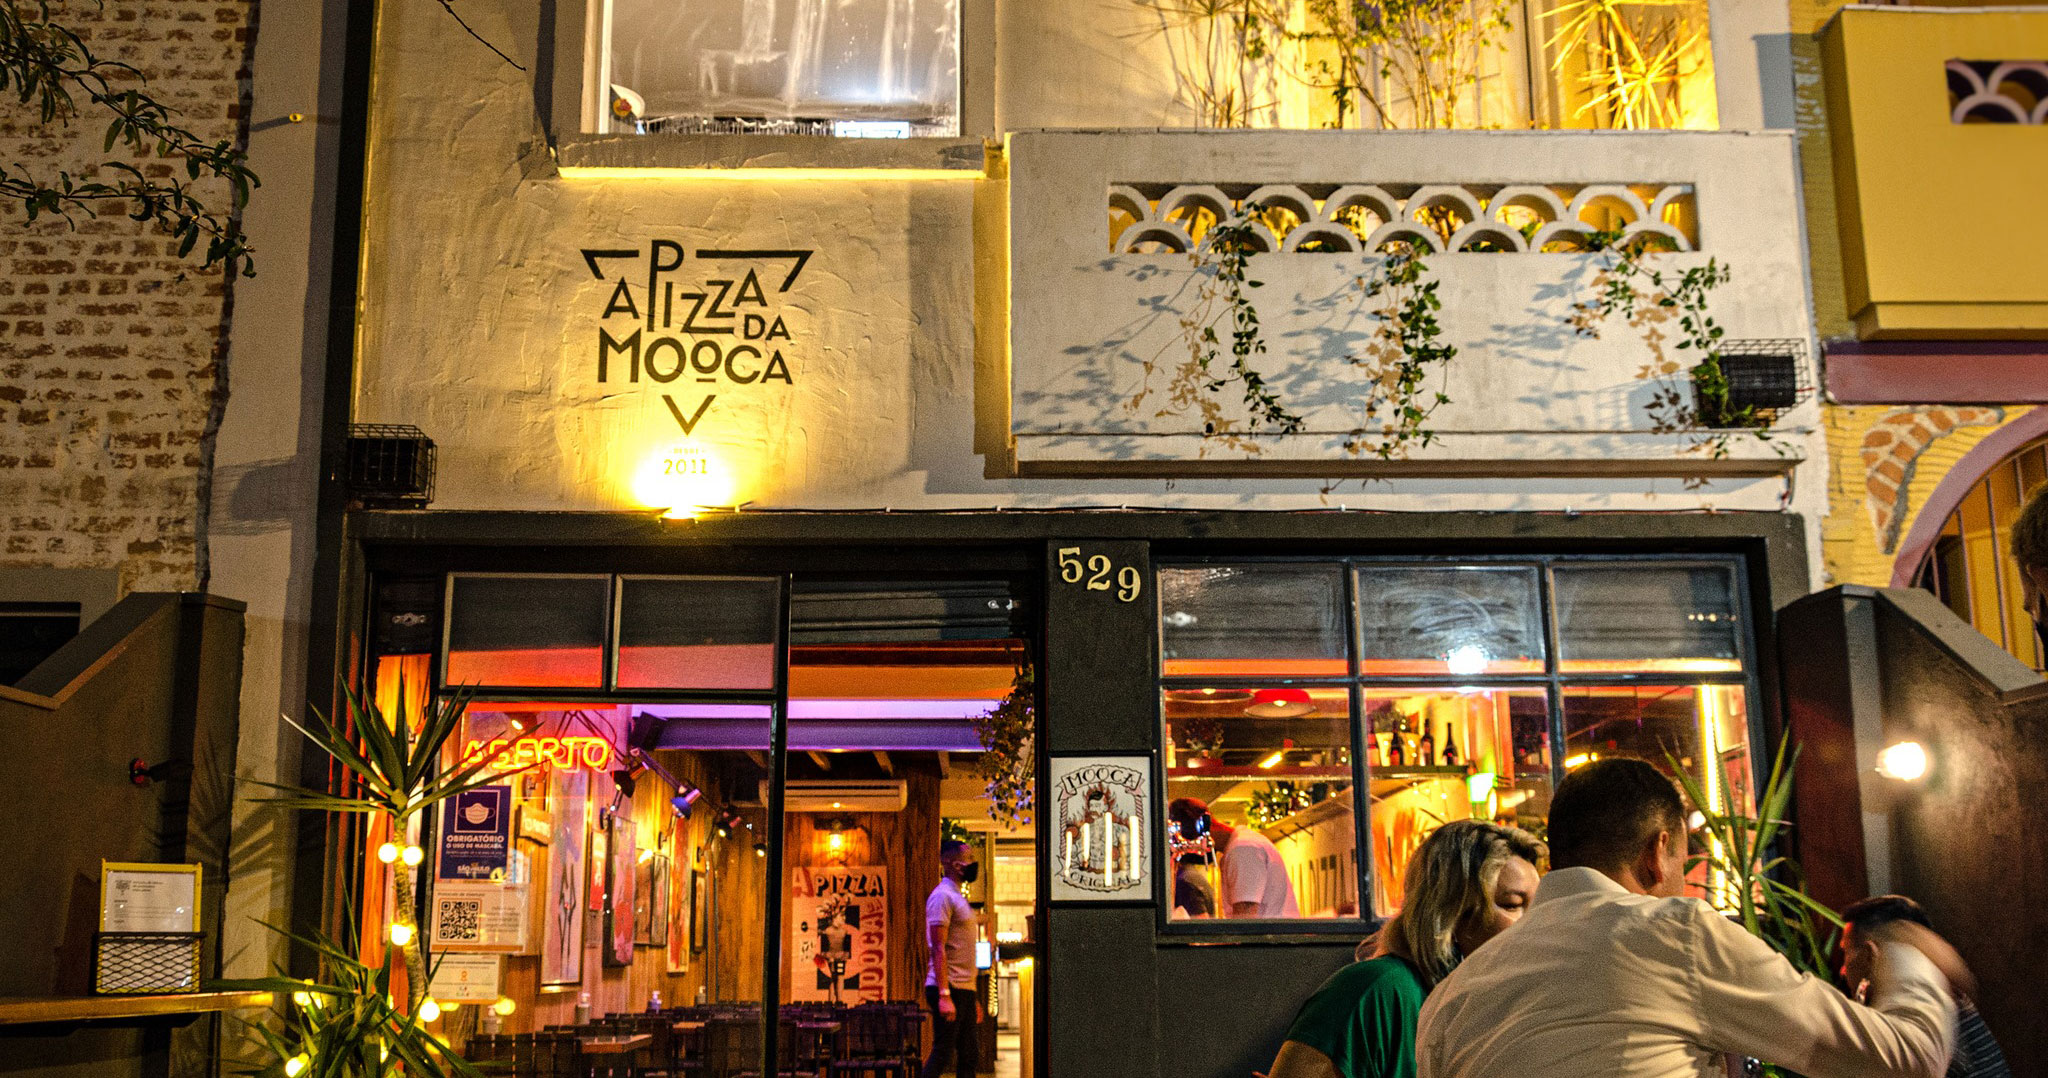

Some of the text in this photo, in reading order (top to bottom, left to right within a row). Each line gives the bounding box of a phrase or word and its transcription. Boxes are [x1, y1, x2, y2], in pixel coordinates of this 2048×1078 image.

[602, 239, 768, 335] A PIZZA
[743, 314, 791, 341] DA
[597, 326, 793, 385] MOOCA
[663, 458, 708, 476] 2011
[1057, 546, 1142, 603] 529
[460, 736, 609, 771] ABERTO
[1065, 767, 1136, 789] MOOCA
[446, 834, 505, 843] OBRIGATÓRIO
[792, 866, 884, 898] A PIZZA
